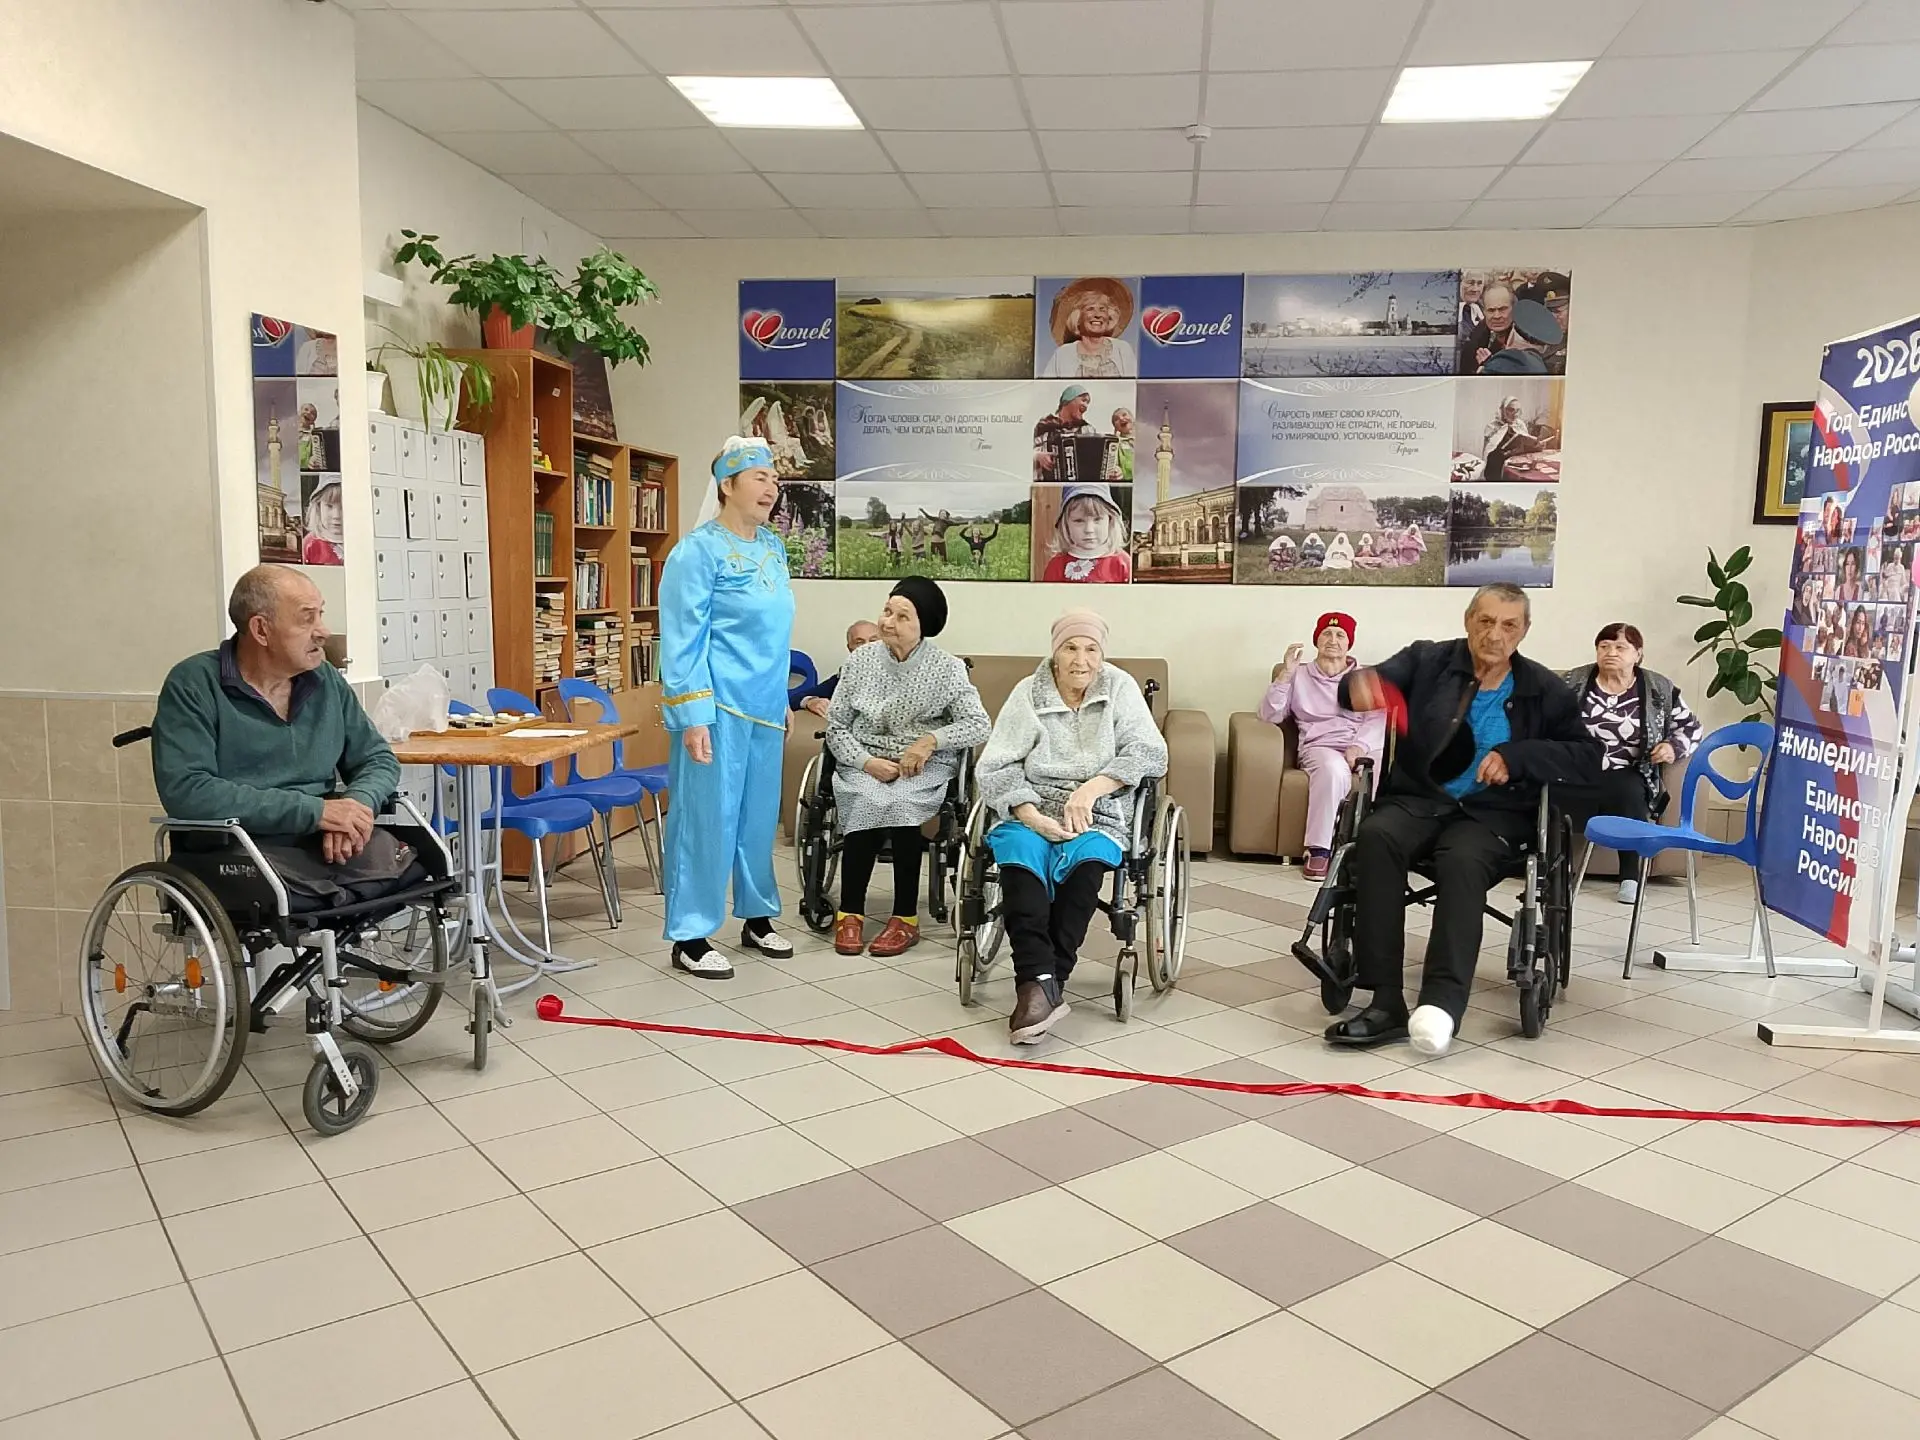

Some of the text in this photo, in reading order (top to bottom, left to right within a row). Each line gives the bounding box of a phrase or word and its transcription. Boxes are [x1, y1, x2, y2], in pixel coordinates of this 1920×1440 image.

[887, 414, 921, 423] ЧЕЛОВЕК
[922, 414, 943, 424] СТАР,
[944, 414, 956, 423] ОН
[957, 414, 989, 424] ДОЛЖЕН
[990, 414, 1023, 423] БОЛЬШЕ
[1312, 410, 1338, 418] ИМЕЕТ
[1339, 410, 1365, 418] СВОЮ
[1366, 410, 1403, 419] КРАСОТУ,
[1272, 421, 1437, 430] РАЗЛИВАЮЩУЮ НЕ СТРАСТИ, НЕ ПОРЫВЫ,
[1825, 410, 1853, 434] Год
[862, 425, 983, 435] ДЕЛАТЬ, ЧЕМ КОГДА БЫЛ МОЛОД
[1271, 432, 1284, 440] НО
[1285, 432, 1342, 441] УМИРЯЮЩУЮ,
[1812, 430, 1920, 470] Народов Росс
[1802, 815, 1880, 869] Народов
[1797, 849, 1864, 901] России
